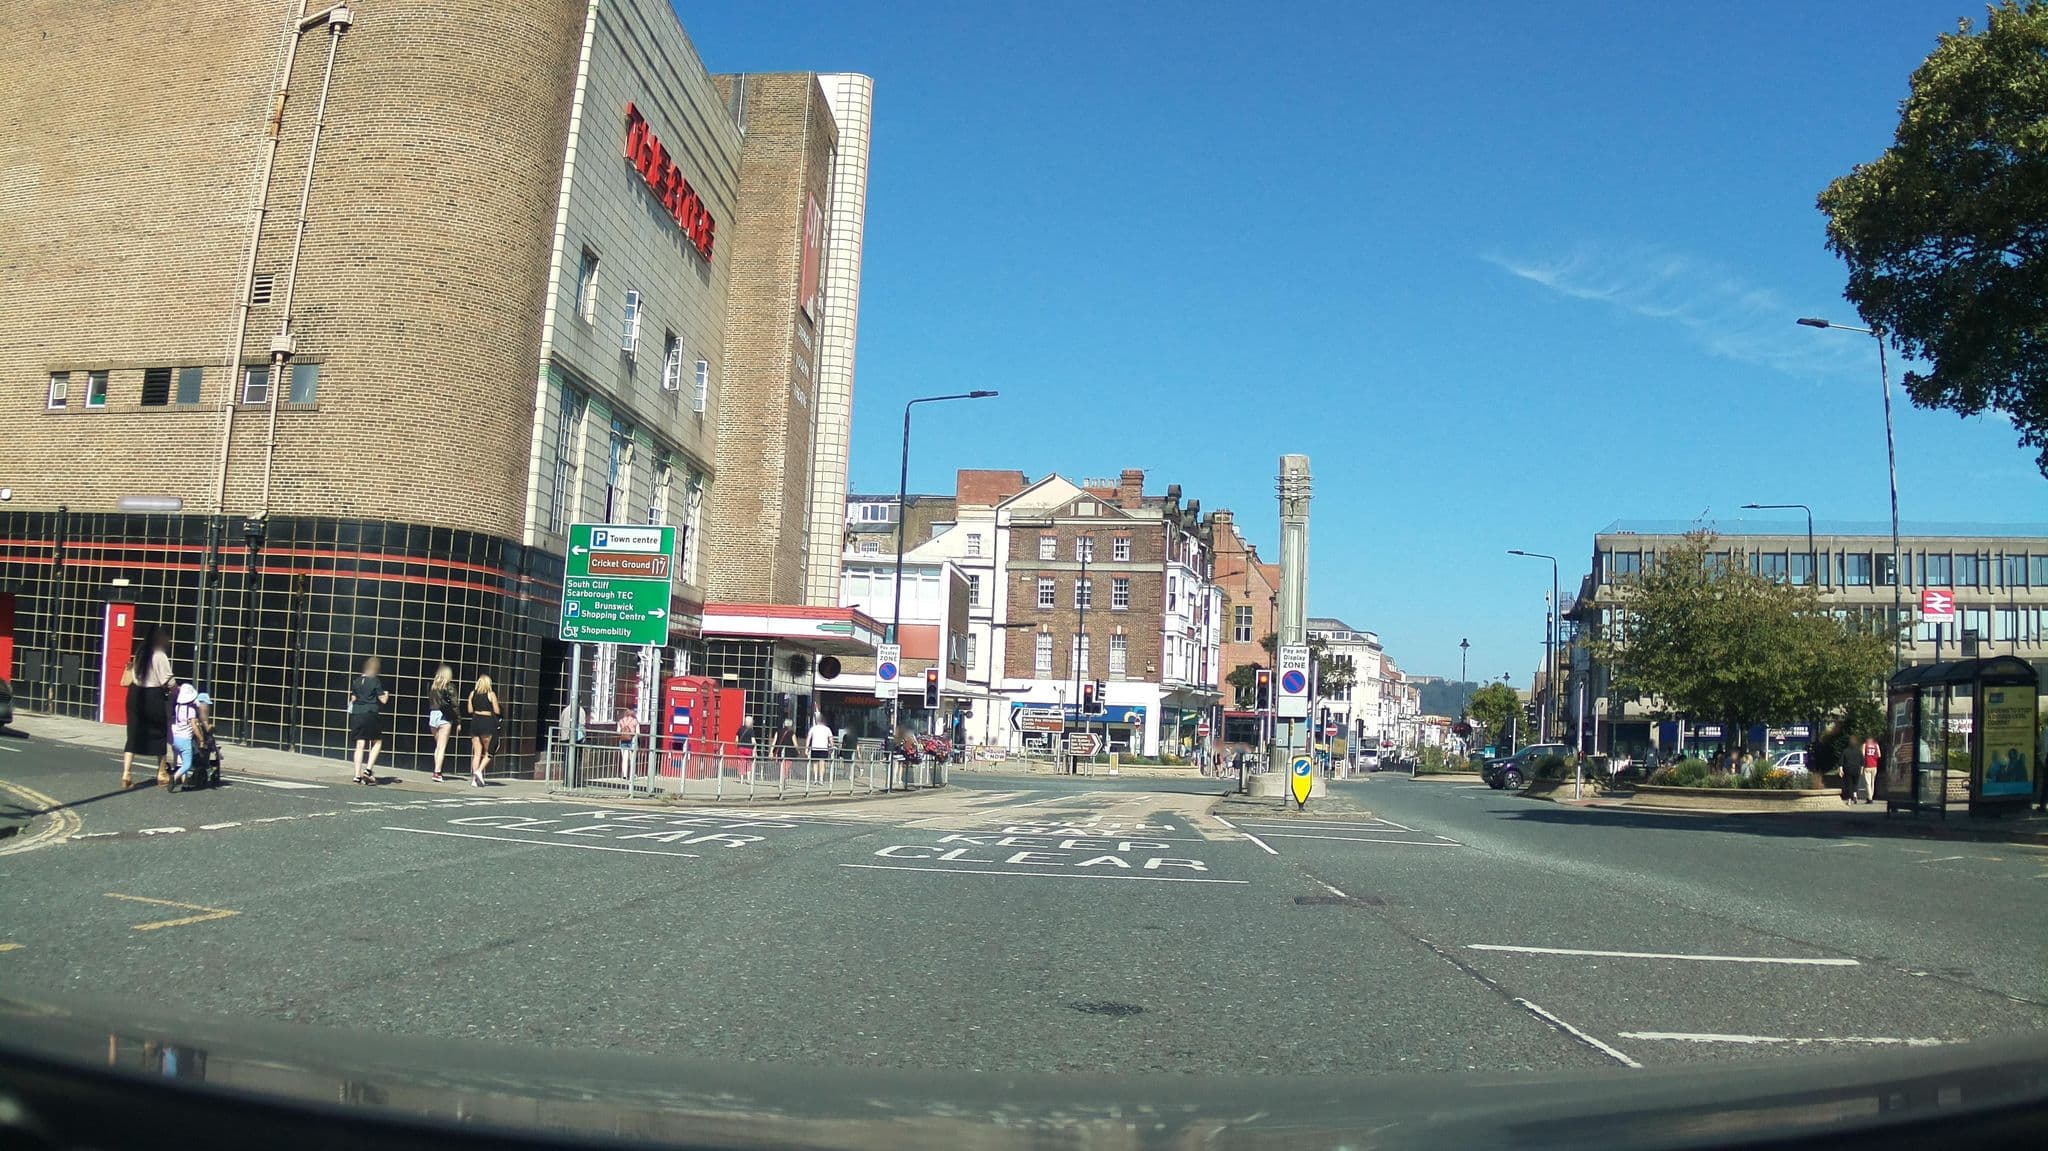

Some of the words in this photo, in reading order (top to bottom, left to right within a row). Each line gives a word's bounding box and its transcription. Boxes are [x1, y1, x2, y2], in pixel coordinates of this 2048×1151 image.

[623, 101, 716, 262] THEATRE
[610, 534, 630, 543] Town
[632, 536, 658, 544] centre
[591, 558, 620, 568] Cricket
[621, 560, 650, 569] Ground
[567, 579, 590, 588] South
[592, 581, 610, 589] Cliff
[567, 589, 615, 600] Scarborough
[617, 591, 634, 599] TEC
[594, 601, 634, 611] Brunswick
[581, 610, 617, 621] Shopping
[619, 612, 646, 621] Centre
[581, 626, 632, 638] Shopmobility
[561, 810, 799, 829] KEEP
[447, 815, 766, 848] CLEAR
[936, 834, 1171, 852] KEEP
[874, 845, 1208, 872] CLEAR
